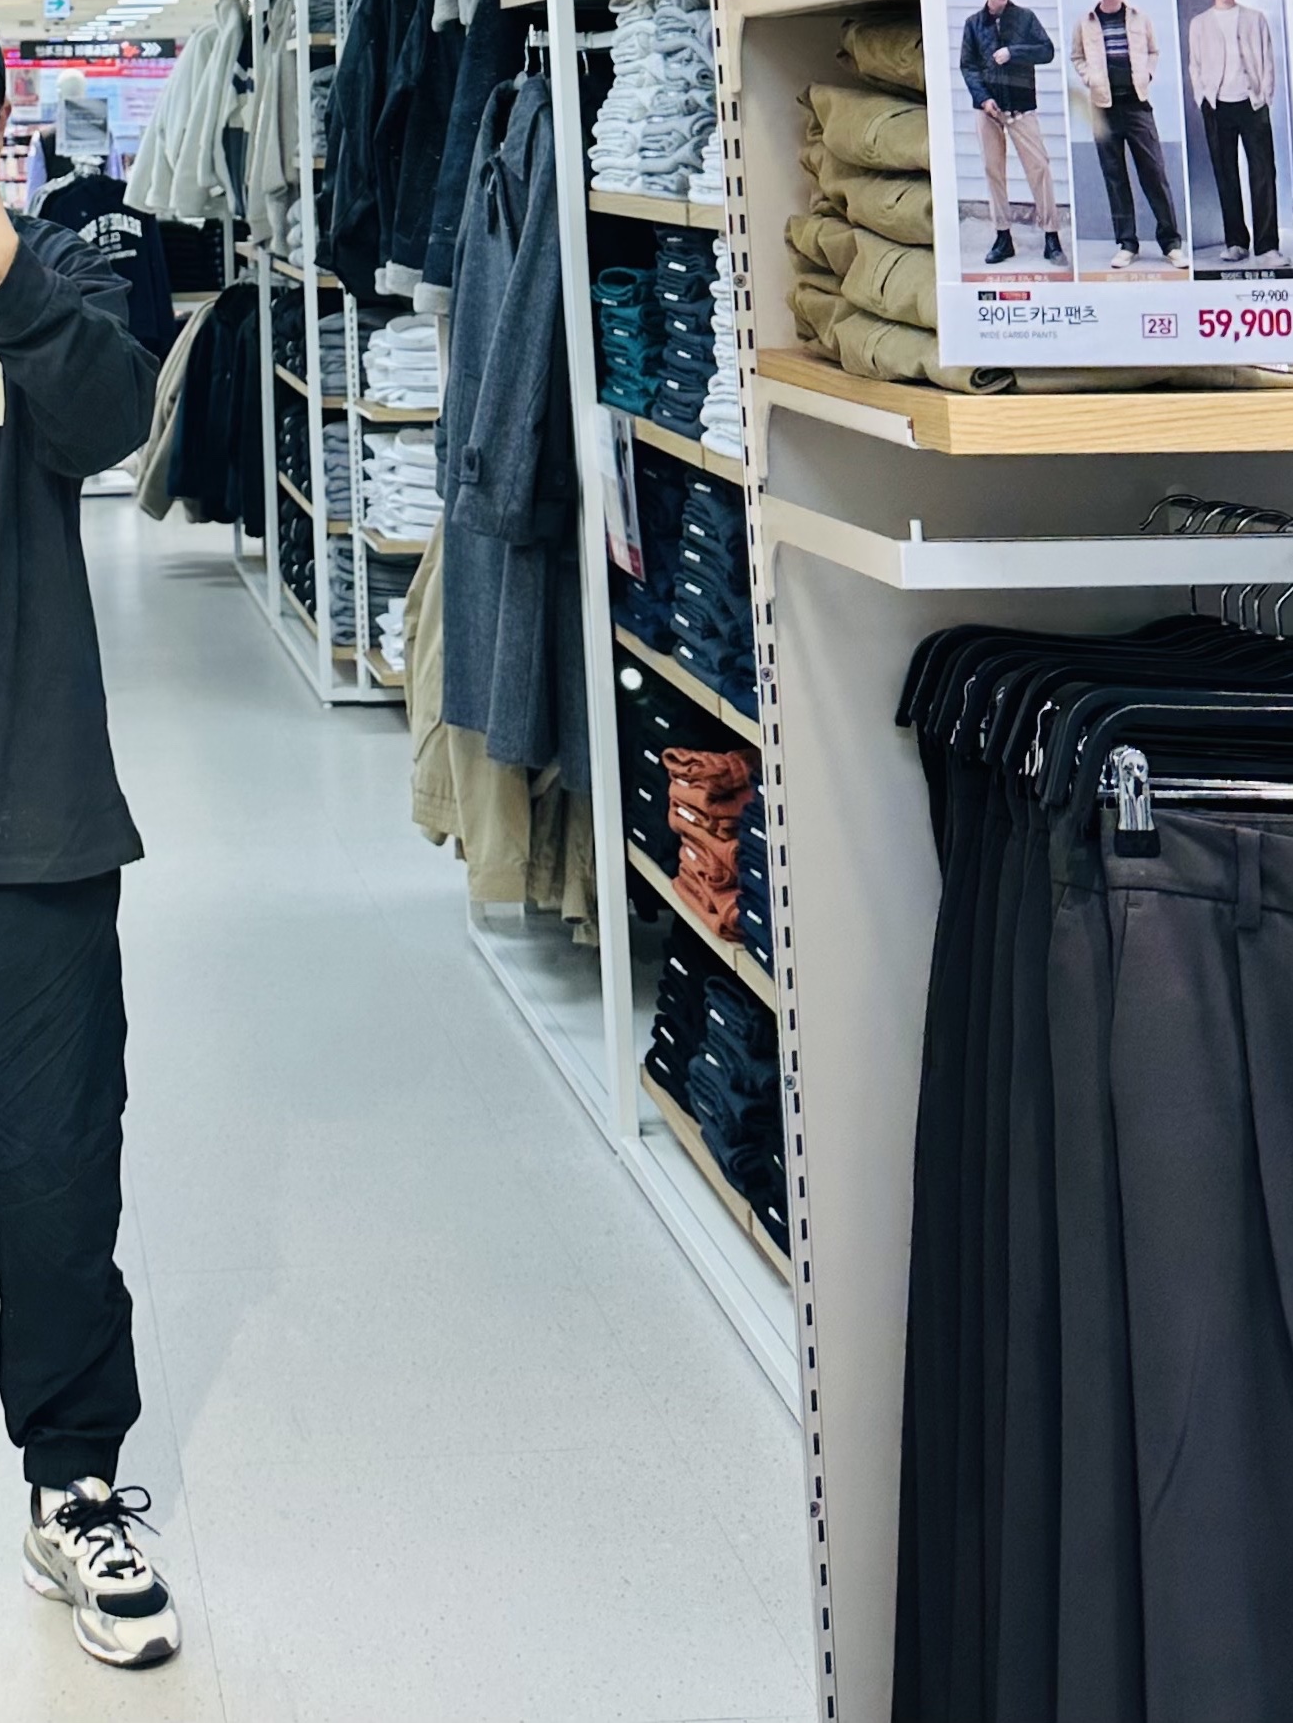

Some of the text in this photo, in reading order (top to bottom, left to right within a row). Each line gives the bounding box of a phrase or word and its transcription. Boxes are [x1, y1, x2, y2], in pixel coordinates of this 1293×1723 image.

[1252, 289, 1289, 304] 59,900
[978, 305, 1099, 325] 와이드 카고 팬츠
[1148, 317, 1172, 335] 2장
[1198, 308, 1292, 343] 59,900
[979, 331, 1001, 339] WIDE
[1031, 331, 1058, 339] PANTS
